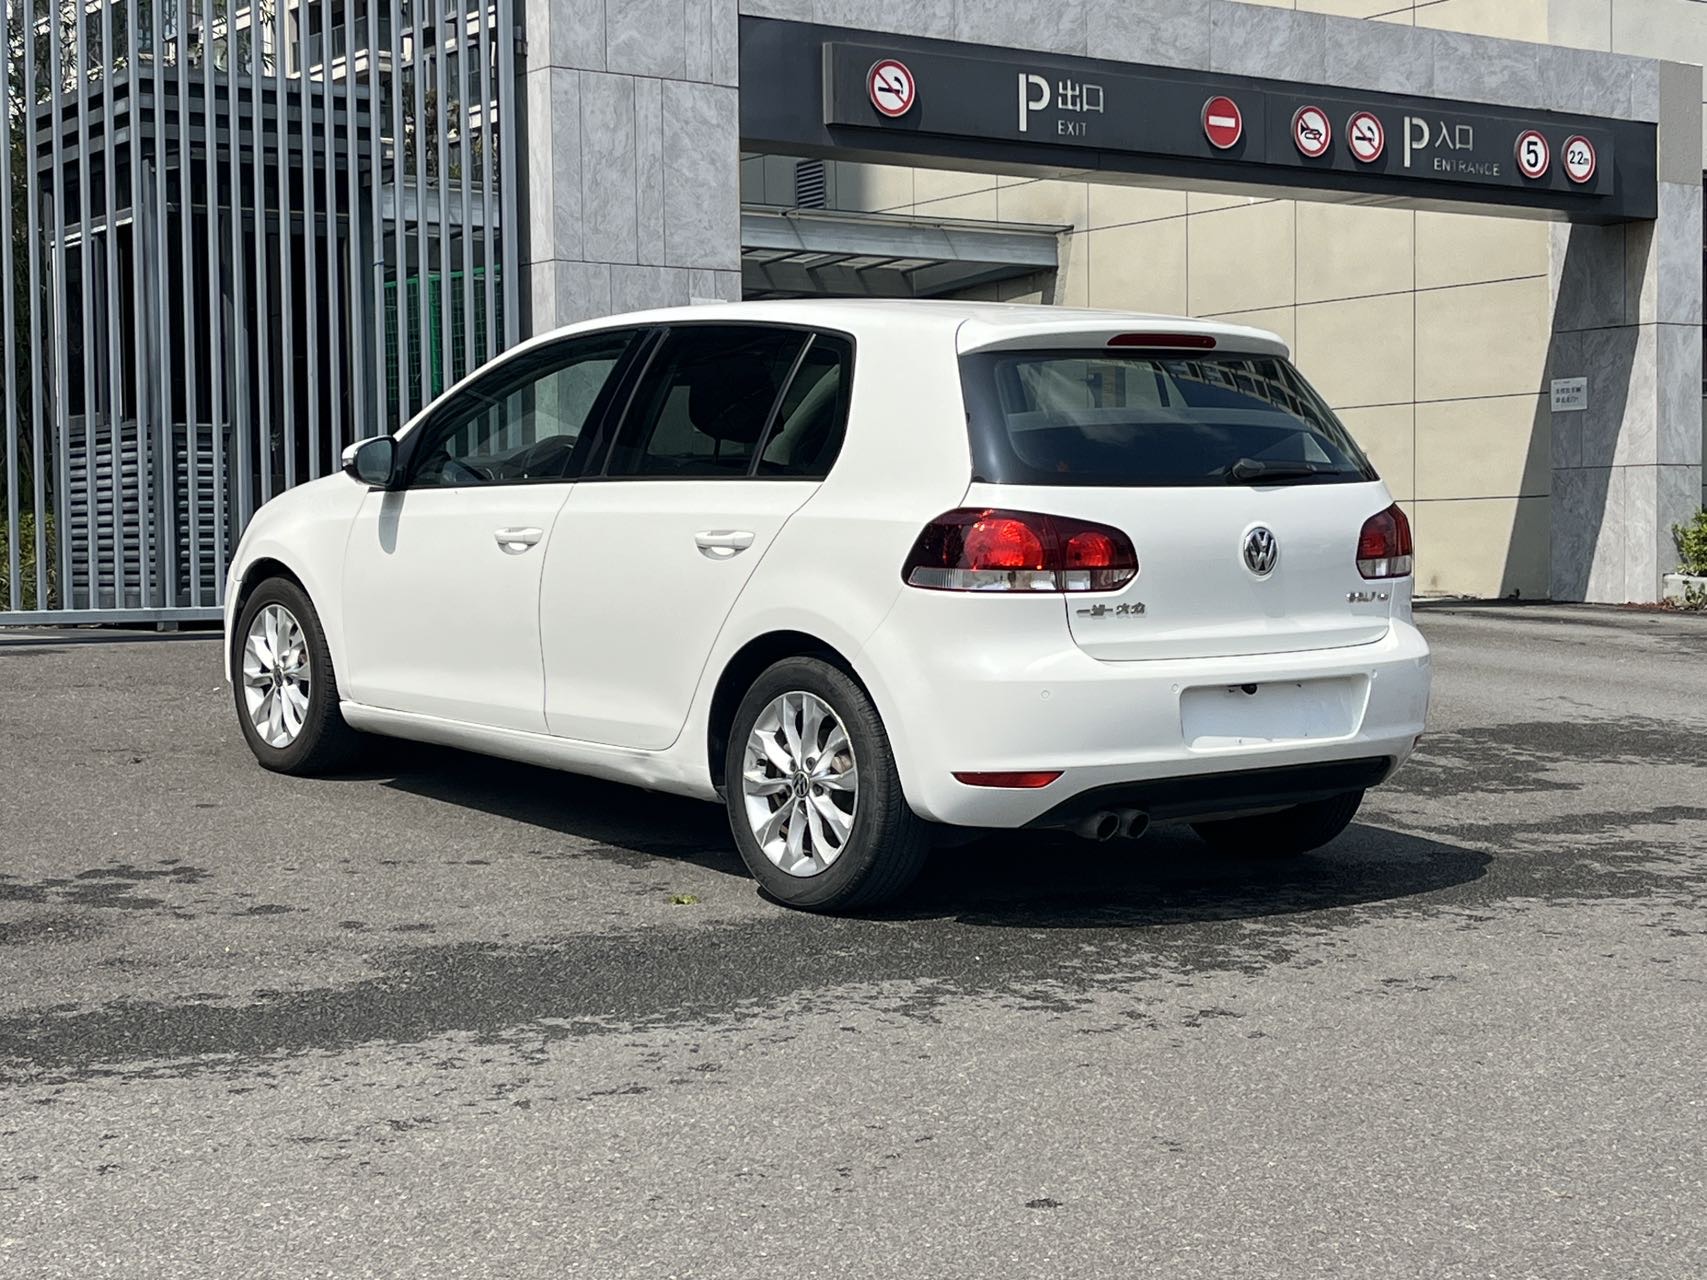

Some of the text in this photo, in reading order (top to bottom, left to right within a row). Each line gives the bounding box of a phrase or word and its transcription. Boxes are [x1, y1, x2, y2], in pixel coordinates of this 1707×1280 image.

[1018, 73, 1051, 132] P
[1058, 80, 1104, 113] 出口
[1058, 120, 1087, 136] EXIT
[1404, 116, 1430, 168] P
[1435, 121, 1473, 151] 入口
[1434, 158, 1500, 176] ENTRANCE
[1527, 141, 1539, 168] 5
